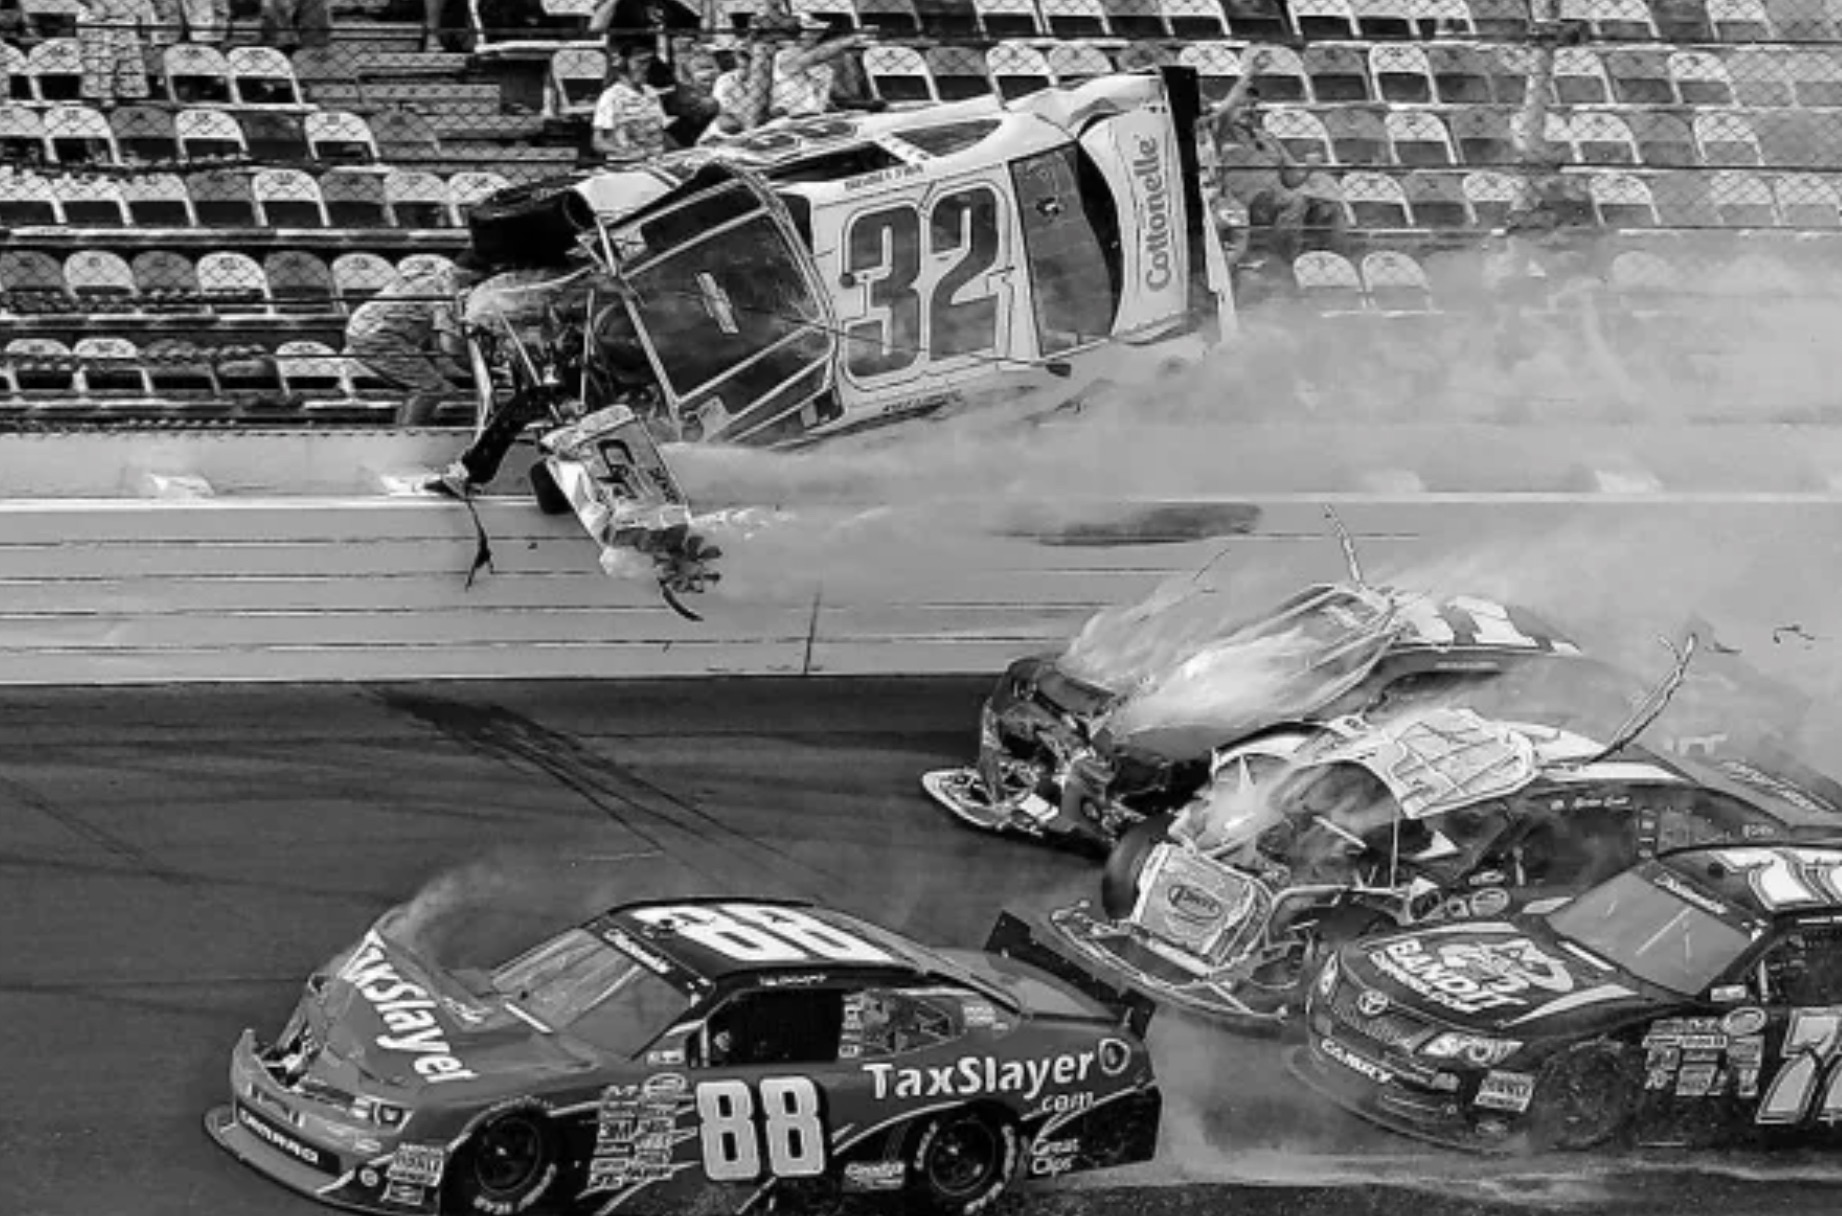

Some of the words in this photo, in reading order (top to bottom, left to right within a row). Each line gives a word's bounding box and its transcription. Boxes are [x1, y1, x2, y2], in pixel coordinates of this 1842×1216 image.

[1134, 136, 1172, 291] Cottonelle
[841, 184, 1001, 380] 32
[631, 903, 894, 961] 88
[340, 928, 479, 1084] TaxSlayer
[696, 1075, 824, 1181] 88
[862, 1050, 1093, 1100] TaxSlayer
